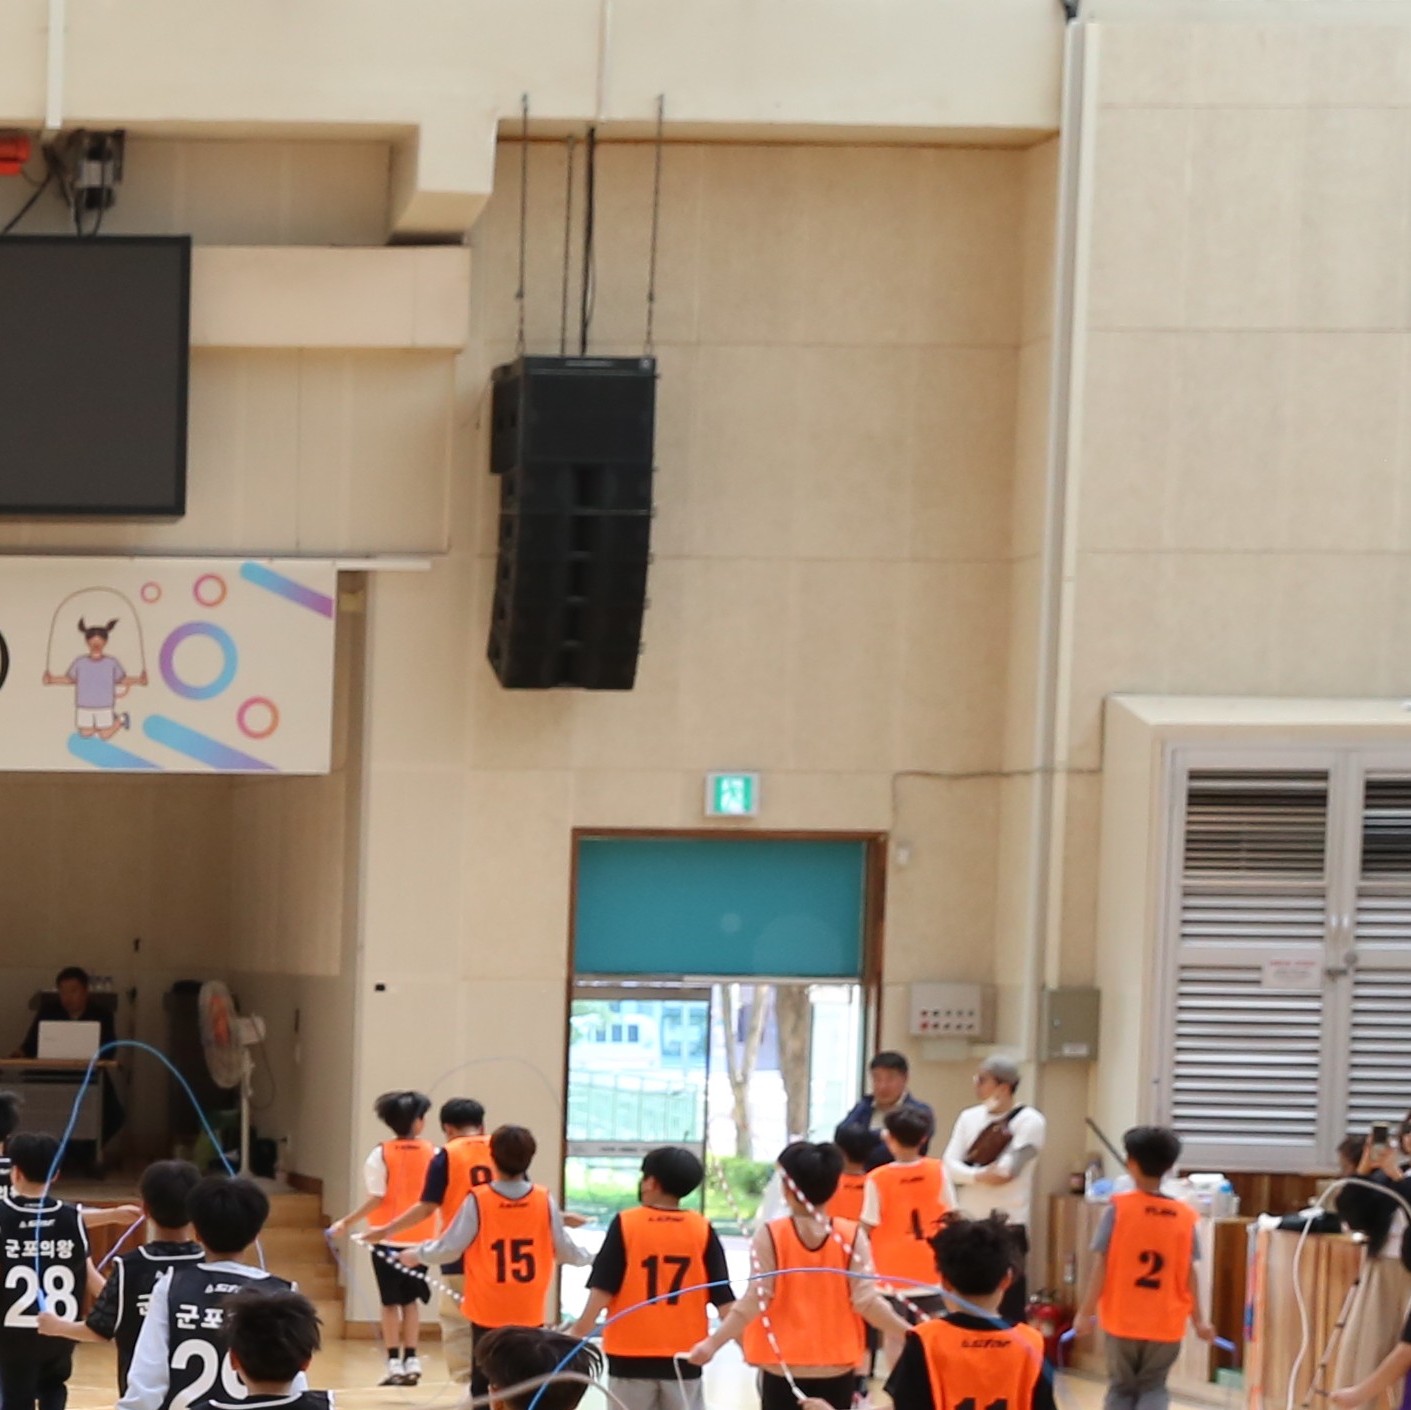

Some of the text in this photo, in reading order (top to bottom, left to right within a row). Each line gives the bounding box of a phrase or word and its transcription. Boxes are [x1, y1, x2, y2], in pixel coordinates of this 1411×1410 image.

[4, 1239, 74, 1260] 군포의왕
[491, 1239, 536, 1284] 15
[1135, 1250, 1165, 1290] 2
[4, 1265, 78, 1328] 28
[641, 1254, 691, 1306] 17
